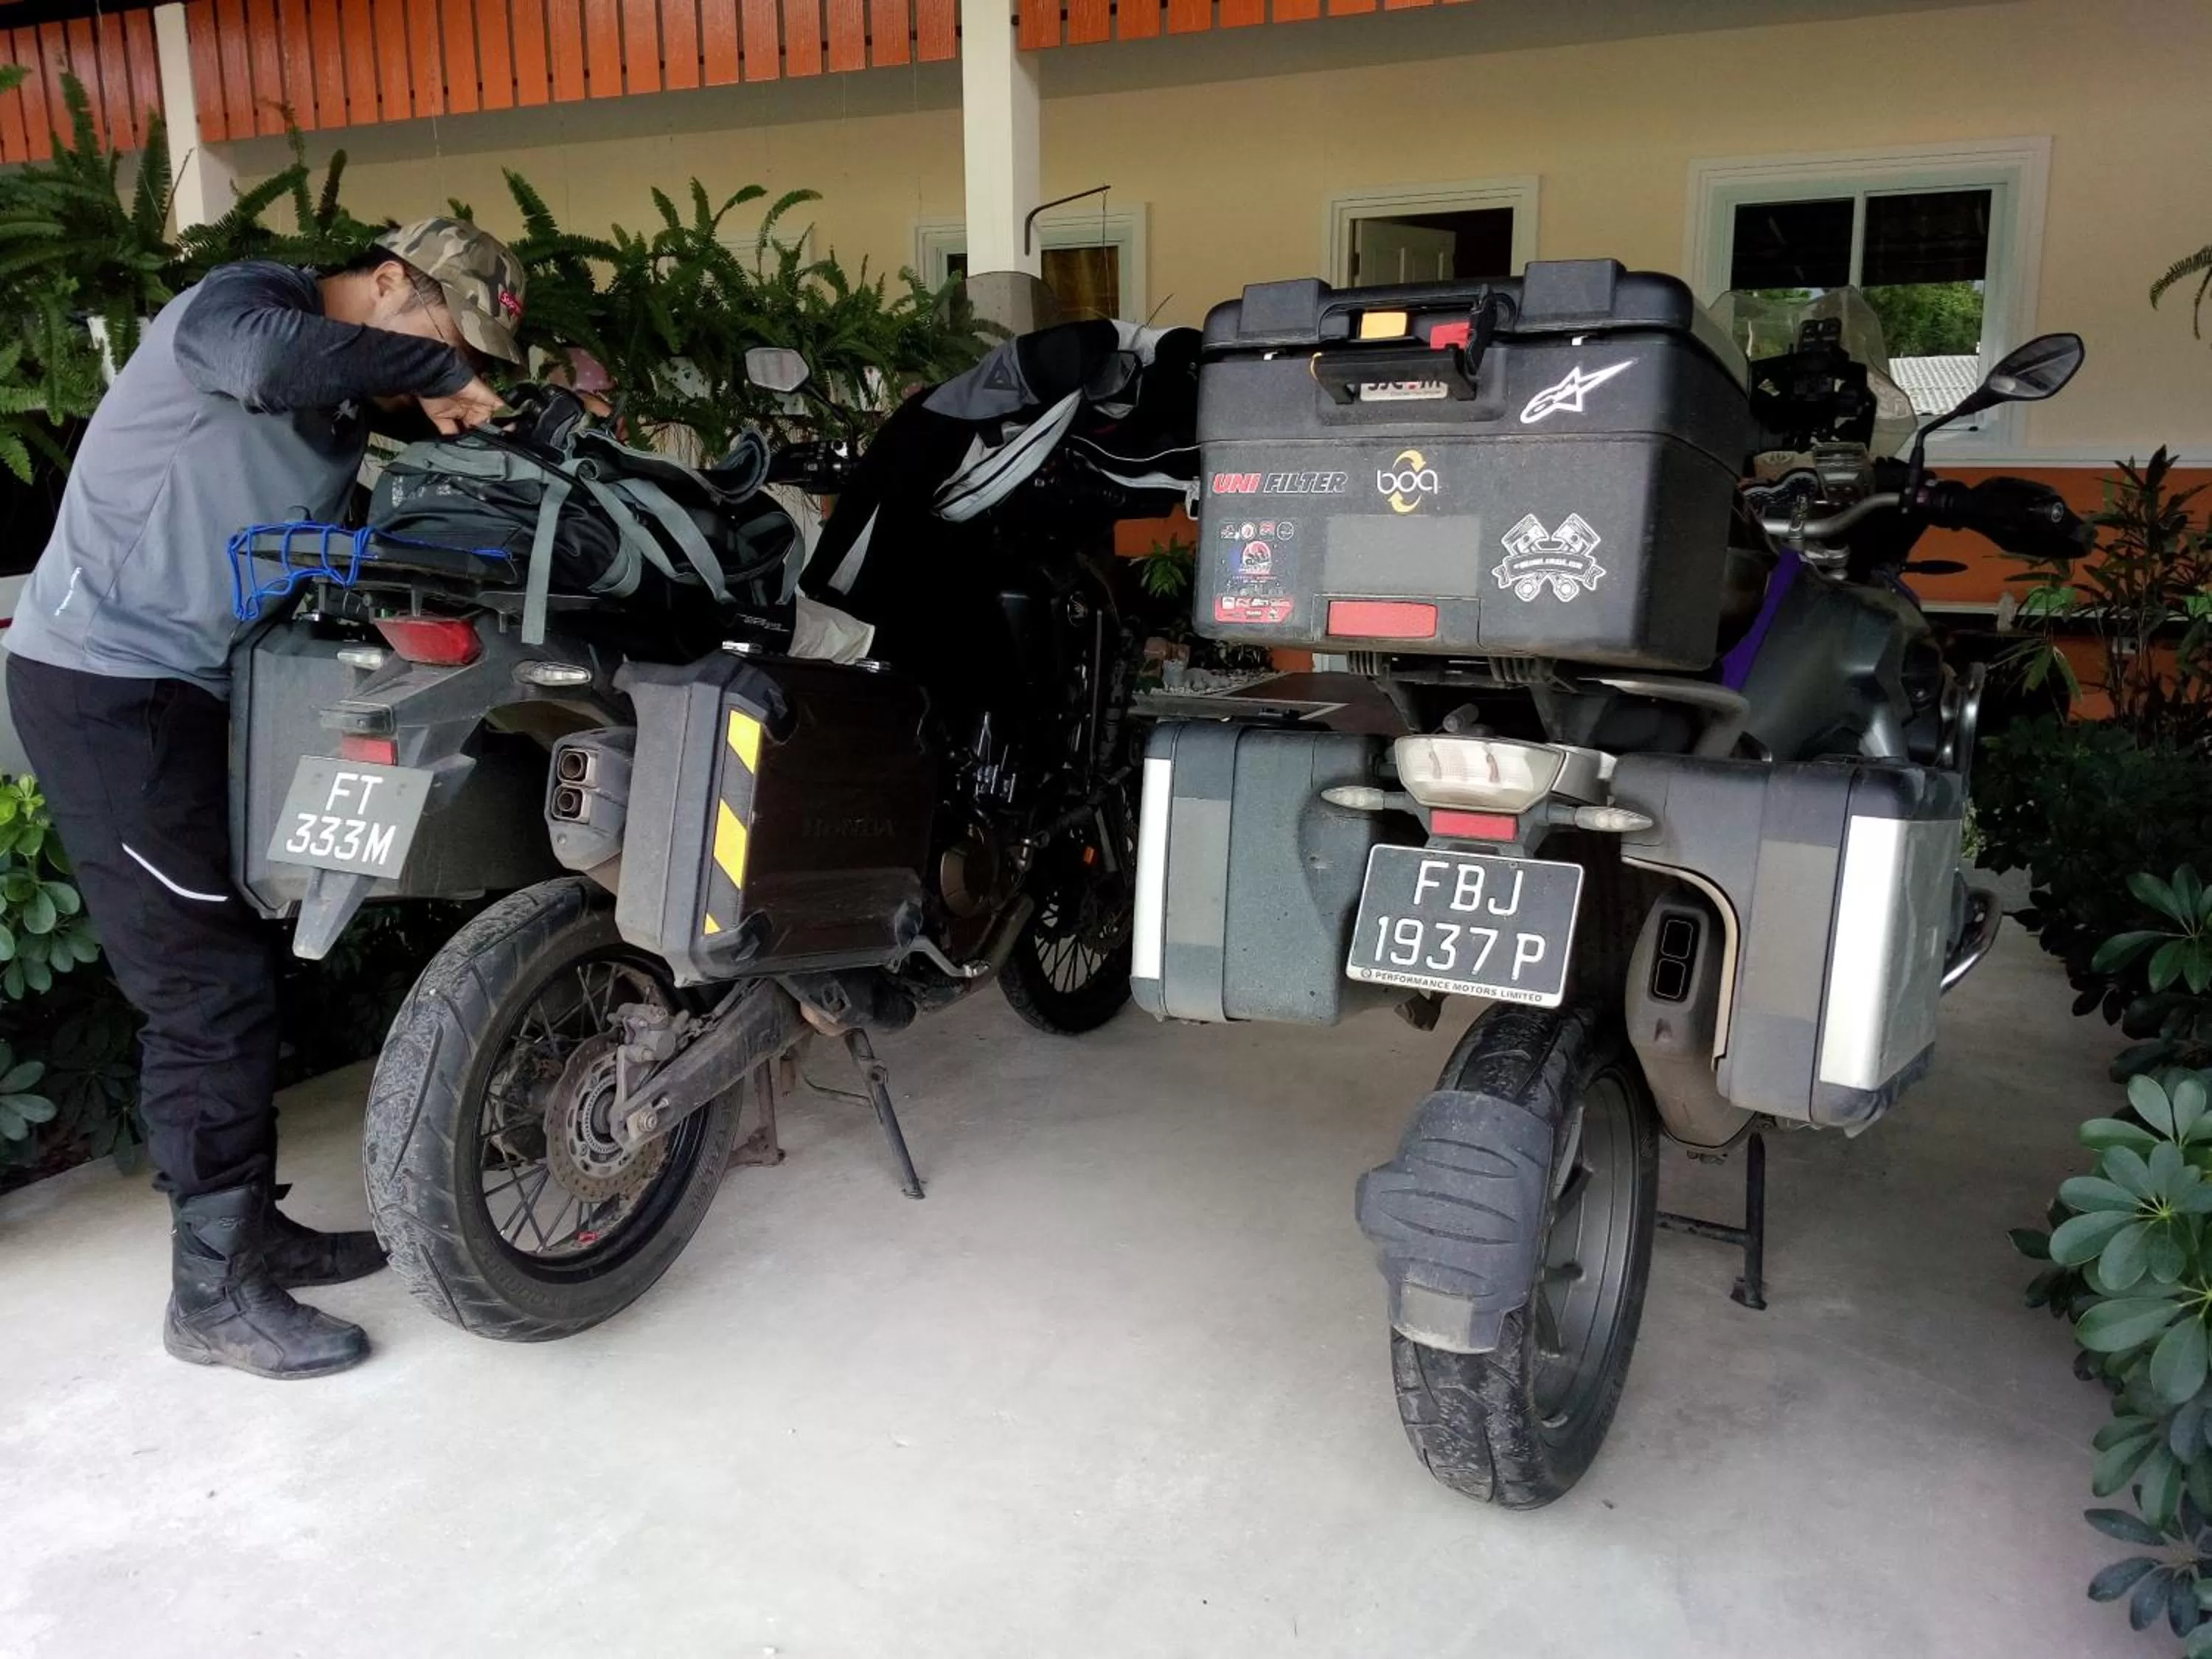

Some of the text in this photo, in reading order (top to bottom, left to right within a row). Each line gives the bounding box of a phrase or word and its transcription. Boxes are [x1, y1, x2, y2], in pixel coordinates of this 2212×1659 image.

[1212, 470, 1349, 494] UNI FILTER
[324, 771, 385, 815] FT
[285, 812, 397, 866] 333M
[1413, 860, 1524, 917] FBJ
[1374, 972, 1543, 1003] PERFORMANCE MOTORS LIMITED
